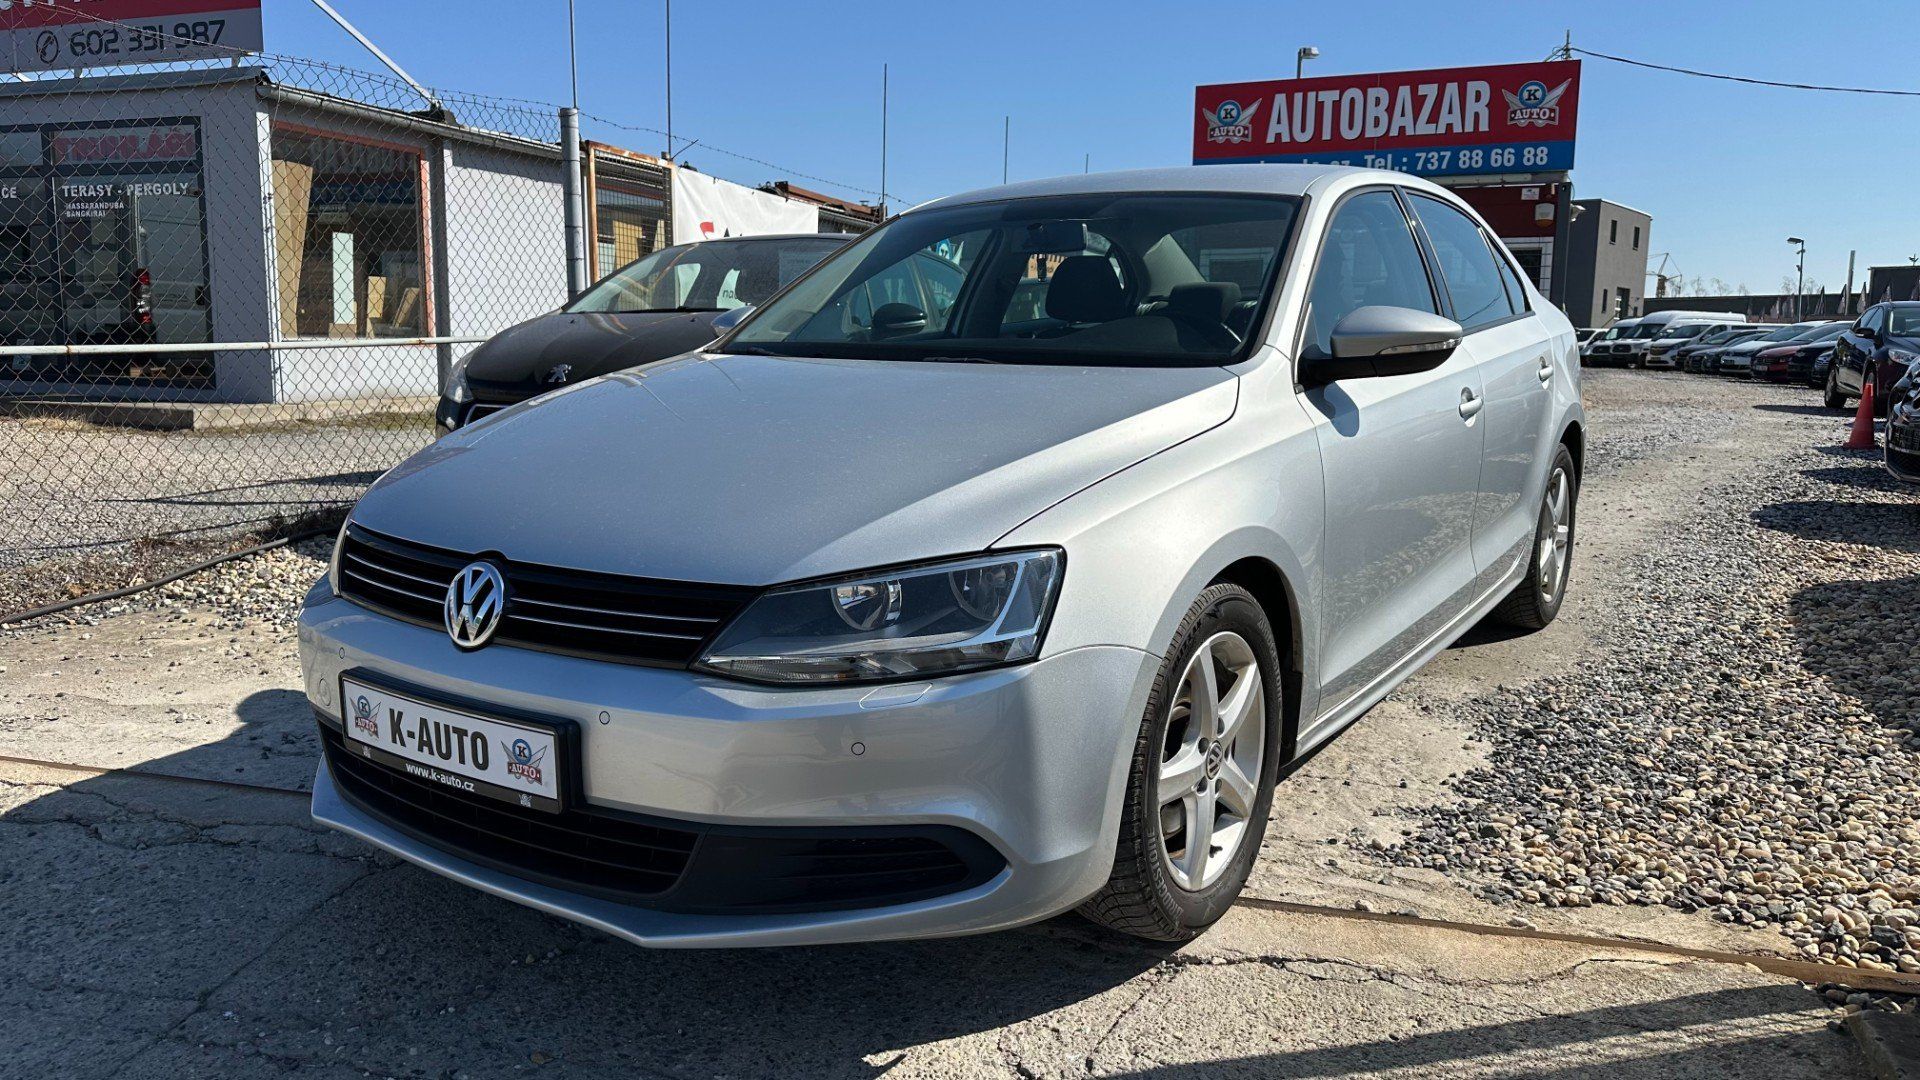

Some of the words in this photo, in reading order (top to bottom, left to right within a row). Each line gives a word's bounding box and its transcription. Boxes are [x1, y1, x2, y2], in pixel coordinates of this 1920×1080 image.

[70, 29, 120, 56] 602
[128, 25, 164, 52] 331
[173, 20, 226, 48] 987
[1526, 89, 1540, 101] K
[1222, 108, 1235, 119] K
[1266, 80, 1491, 144] AUTOBAZAR
[1514, 108, 1550, 120] AUTO
[1213, 126, 1244, 137] AUTO
[1415, 151, 1451, 171] 737
[1458, 150, 1483, 169] 88
[1490, 148, 1515, 167] 66
[1523, 146, 1548, 166] 88
[62, 184, 112, 197] TERASY
[126, 182, 189, 196] PERGOLY
[389, 708, 490, 771] K-AUTO
[516, 745, 529, 759] K
[405, 762, 475, 792] www.k-auto.cz
[511, 763, 537, 779] AUTO
